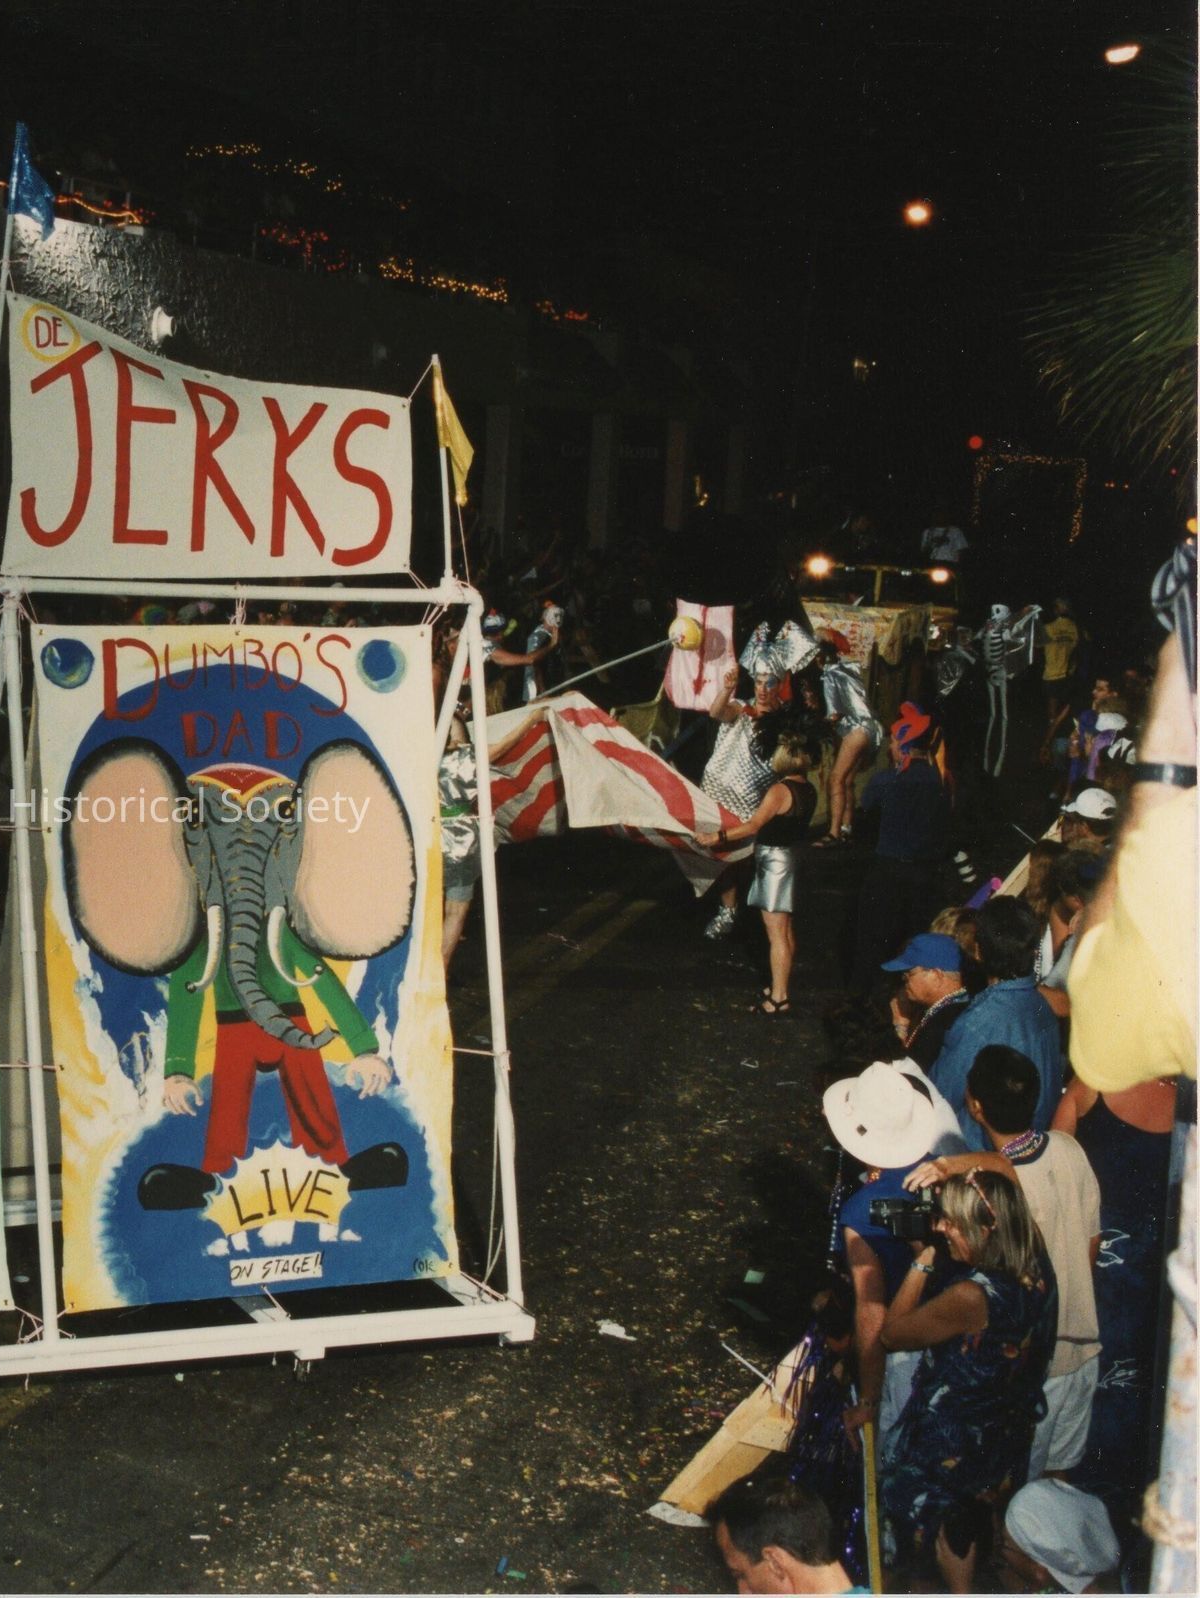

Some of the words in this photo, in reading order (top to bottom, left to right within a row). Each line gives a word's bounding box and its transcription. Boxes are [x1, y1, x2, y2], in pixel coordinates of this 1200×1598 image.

[35, 316, 69, 348] DE
[20, 340, 393, 566] JERKS
[102, 632, 351, 722] DUMBO'S
[181, 710, 303, 759] DAD
[228, 1168, 339, 1226] LIVE
[230, 1263, 254, 1280] ON
